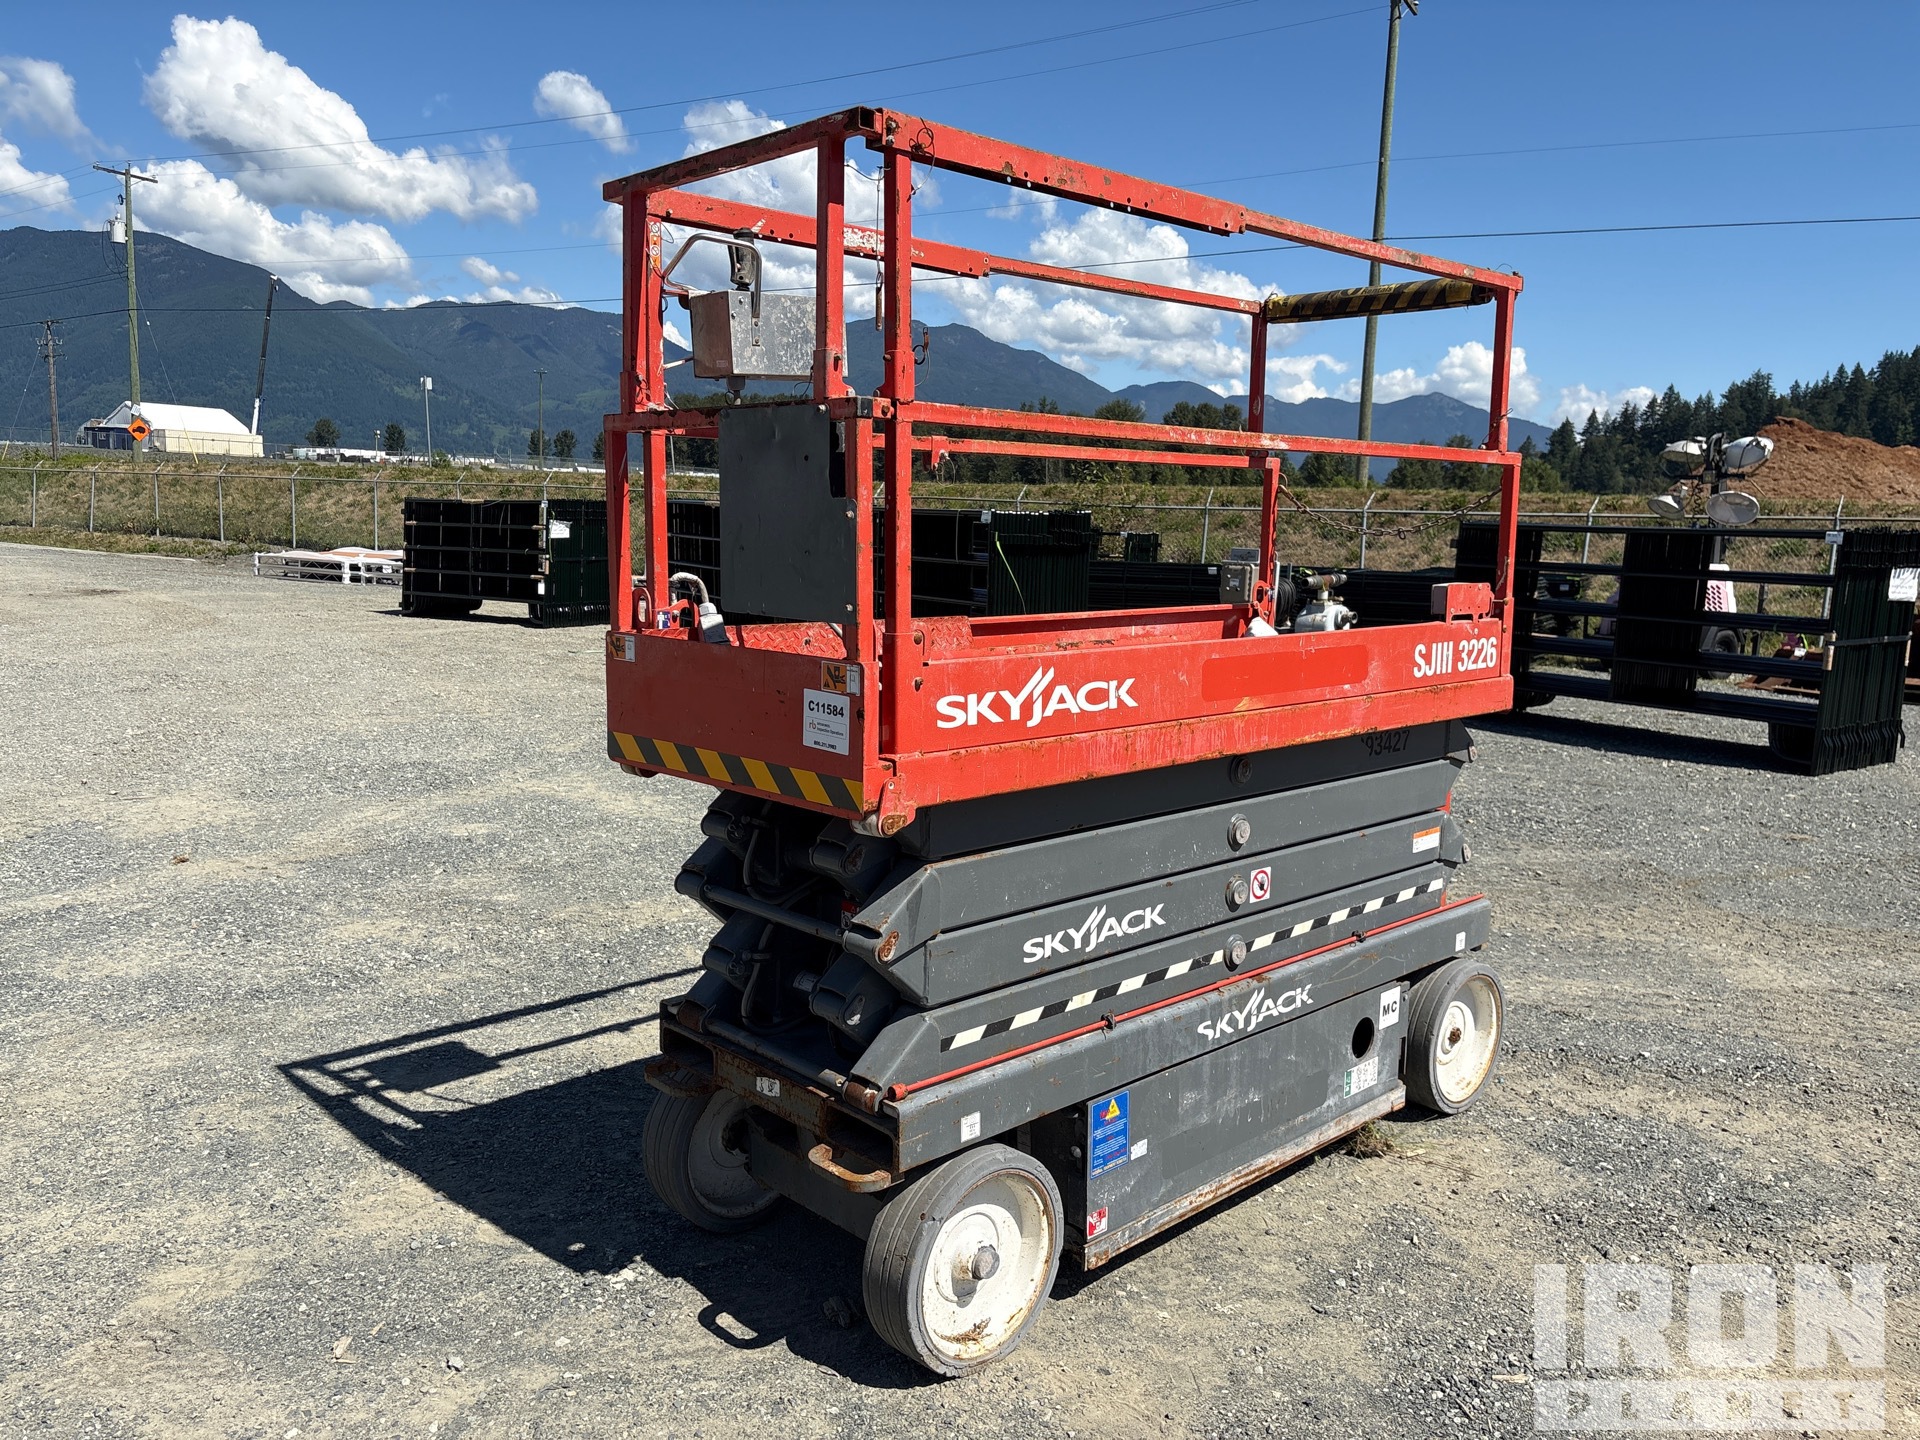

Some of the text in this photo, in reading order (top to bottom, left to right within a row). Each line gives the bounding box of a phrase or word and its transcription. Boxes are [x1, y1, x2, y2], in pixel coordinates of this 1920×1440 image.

[1457, 636, 1497, 672] 3226
[808, 700, 844, 718] C11584
[936, 666, 1138, 728] SKYJACK
[1023, 903, 1167, 964] SKYJACK
[1197, 983, 1314, 1041] SKYJACK
[1382, 1000, 1397, 1017] MC
